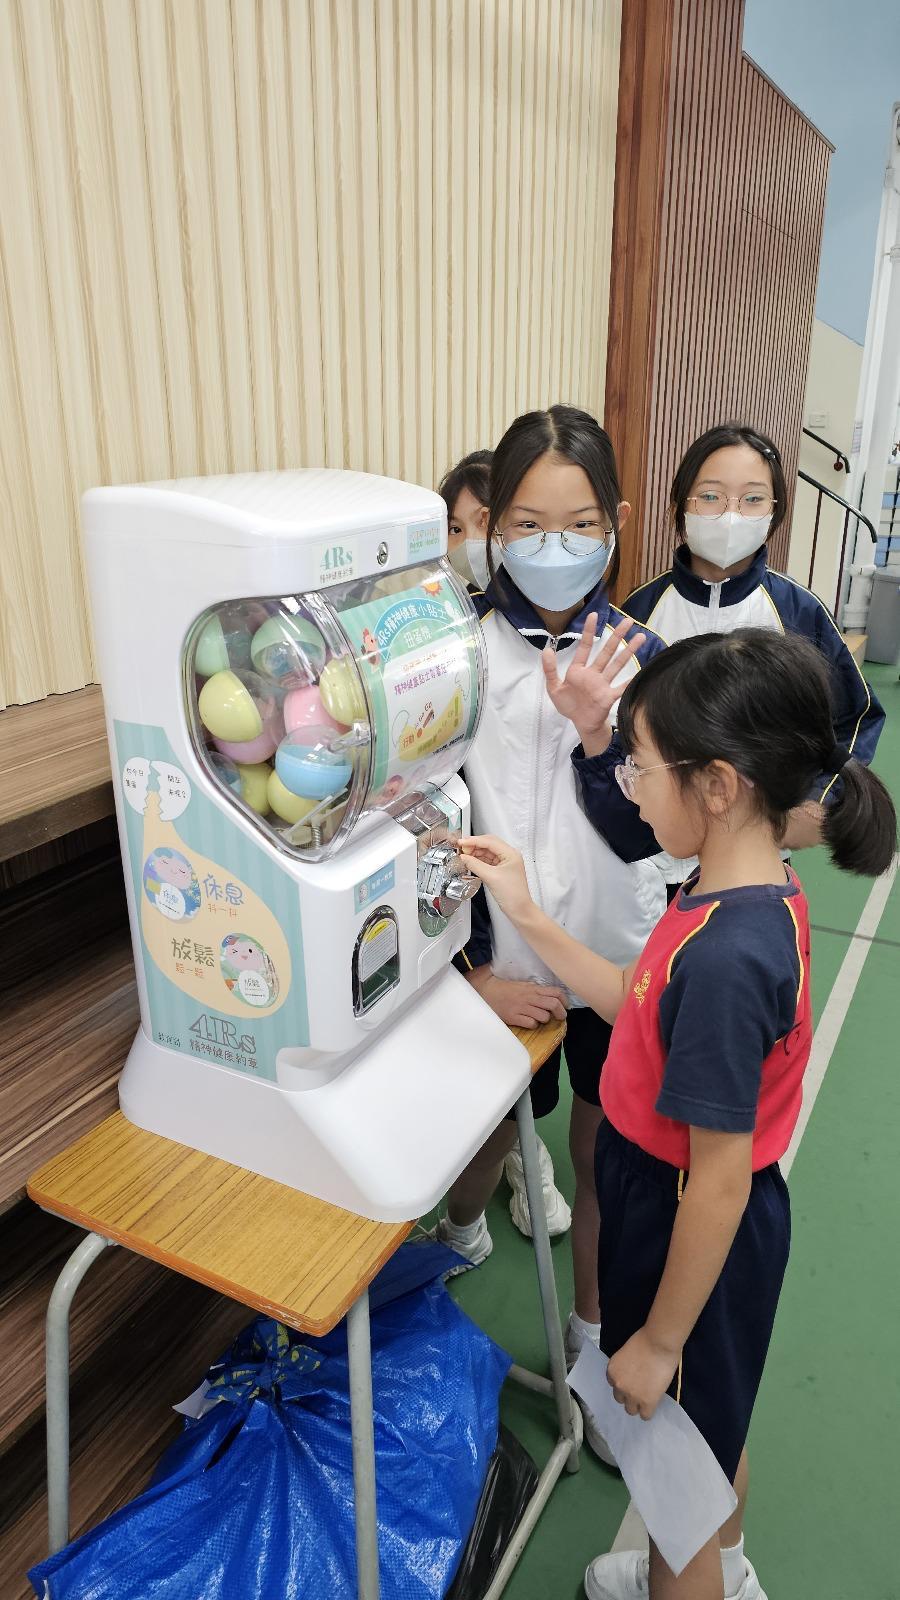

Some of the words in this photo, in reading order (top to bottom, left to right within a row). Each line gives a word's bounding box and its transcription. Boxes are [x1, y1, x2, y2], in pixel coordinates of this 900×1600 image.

[319, 546, 353, 570] 4Rs
[202, 872, 245, 906] 休息
[171, 937, 215, 968] 放鬆
[188, 1013, 257, 1055] 4Rs
[189, 1038, 259, 1070] 精神健康約章
